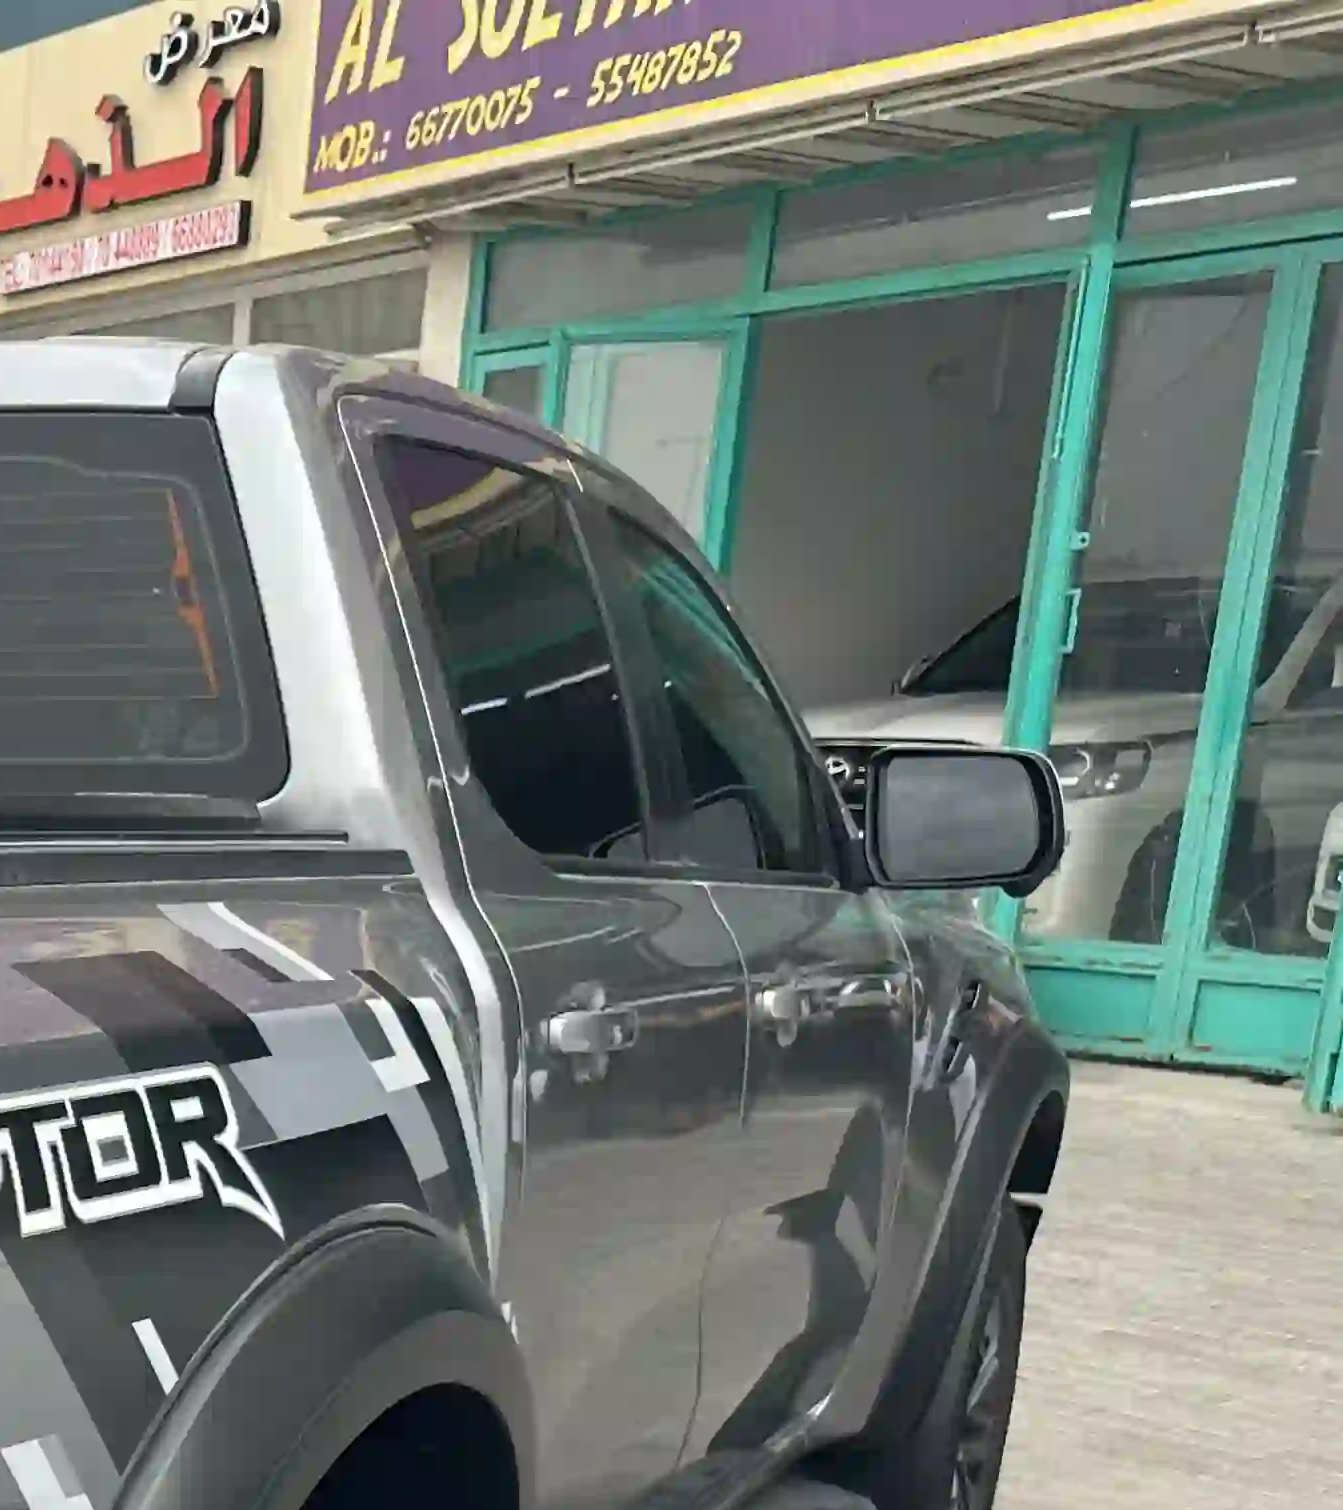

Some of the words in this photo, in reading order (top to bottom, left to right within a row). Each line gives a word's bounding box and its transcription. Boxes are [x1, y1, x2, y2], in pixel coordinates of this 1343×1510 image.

[144, 0, 280, 85] معرض
[325, 0, 406, 103] AL
[406, 77, 541, 150] 66770075
[587, 31, 743, 108] 55487852
